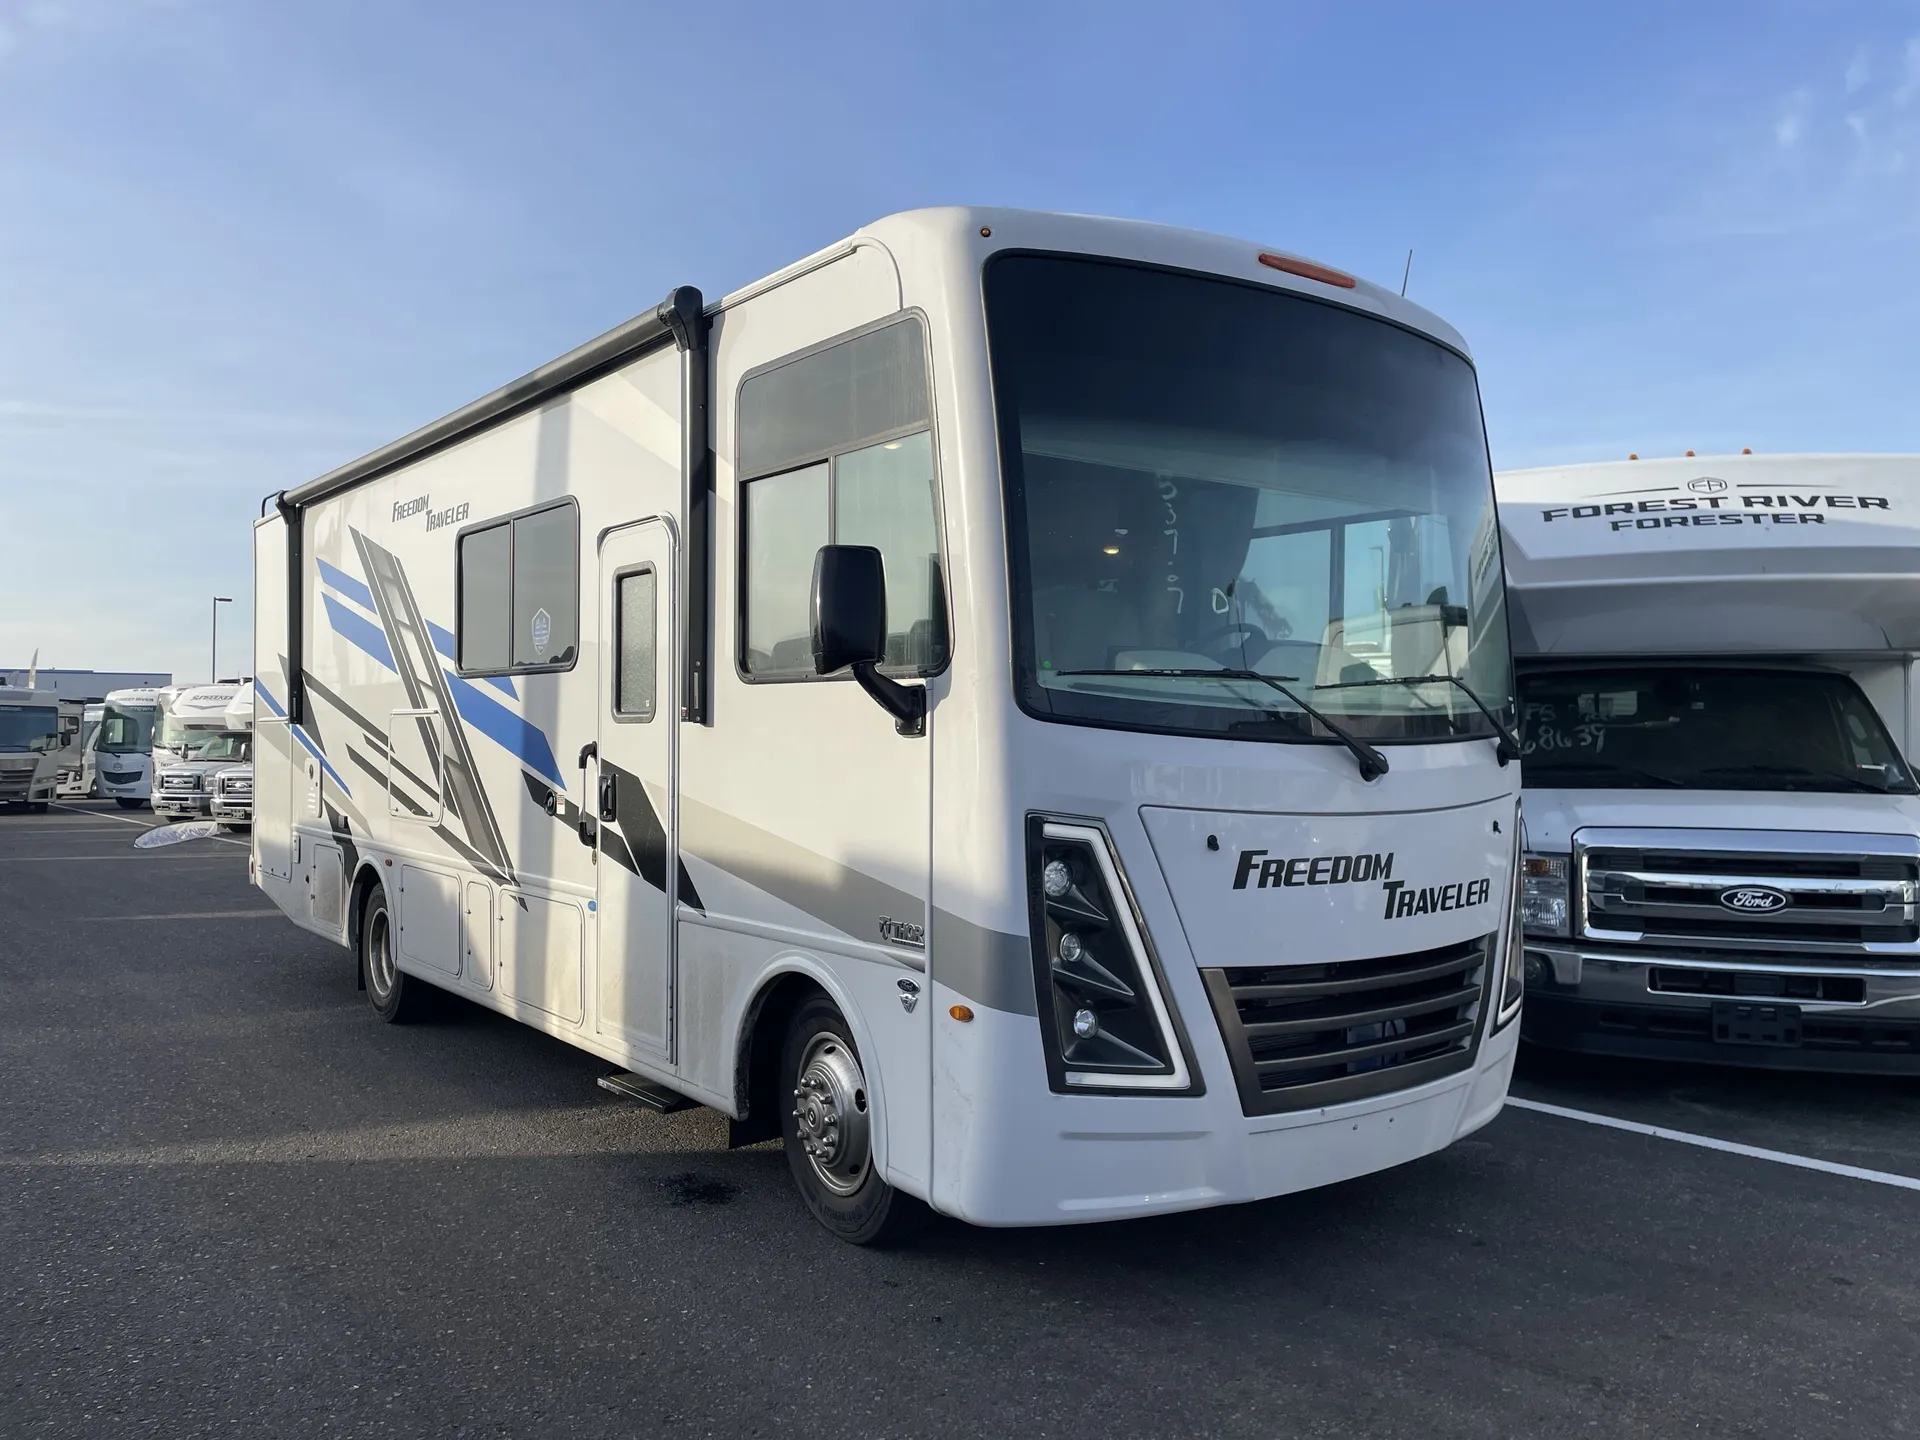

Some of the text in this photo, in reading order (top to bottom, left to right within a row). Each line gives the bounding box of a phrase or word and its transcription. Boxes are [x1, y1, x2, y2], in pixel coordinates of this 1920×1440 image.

[392, 494, 430, 523] FREEDOM
[425, 502, 470, 532] TRAVELER
[1541, 495, 1892, 522] FOREST RIVER
[1609, 513, 1827, 532] FORESTER
[1232, 849, 1395, 890] FREEDOM
[1382, 877, 1491, 920] TRAVELER
[1733, 890, 1774, 907] Ford
[891, 920, 925, 944] THOR
